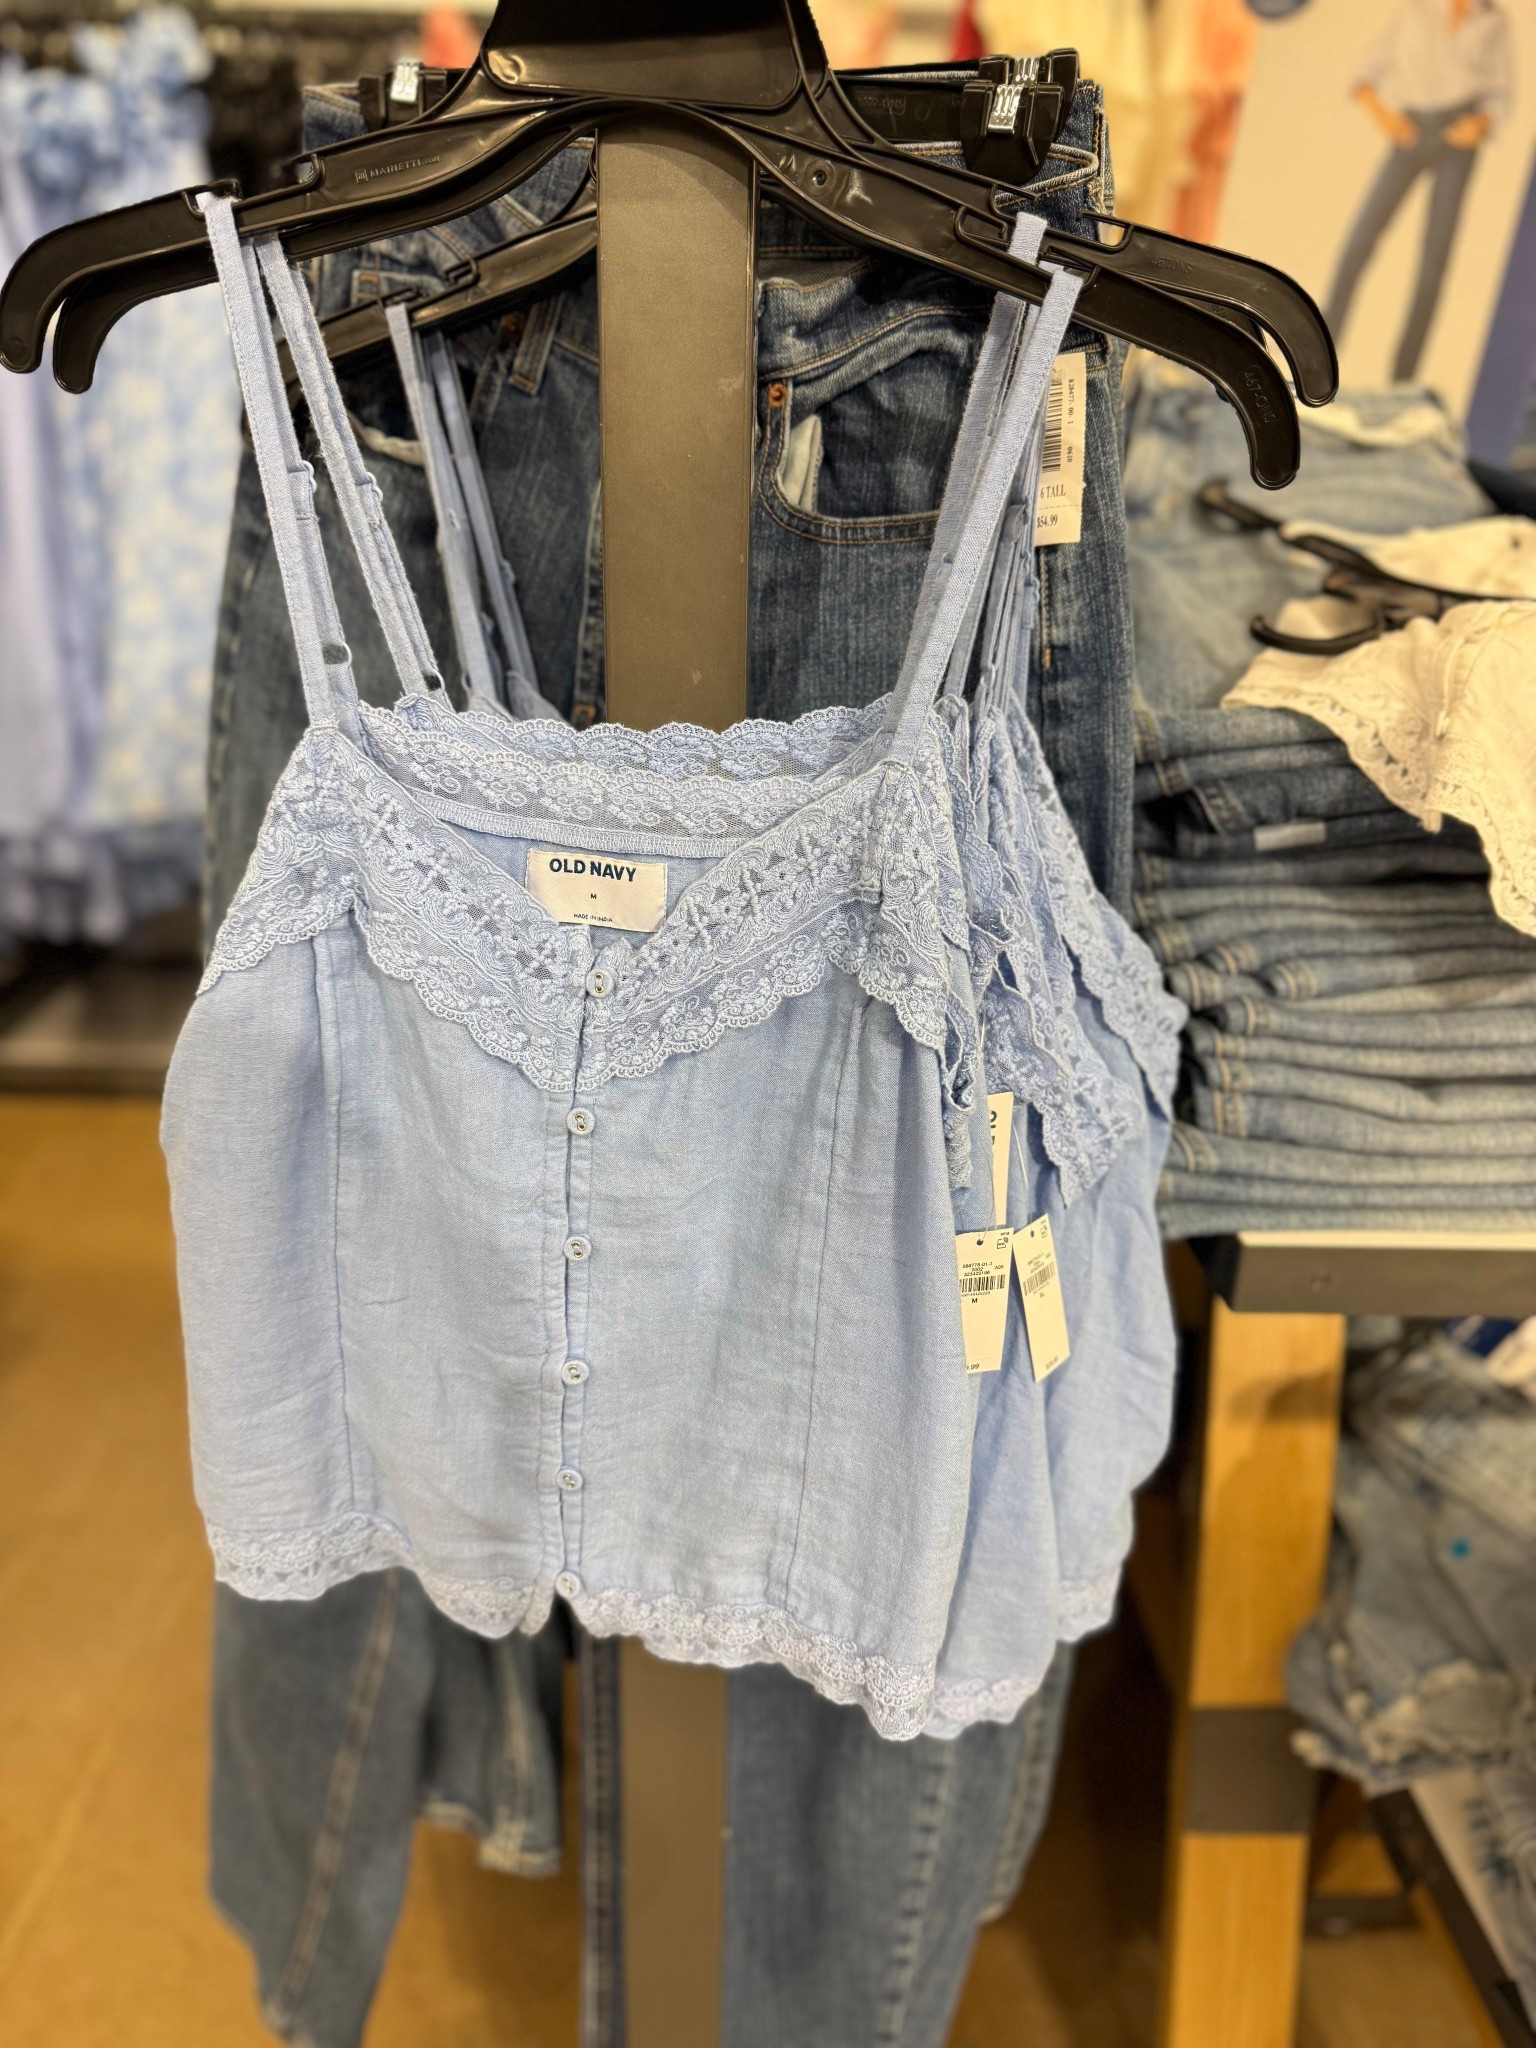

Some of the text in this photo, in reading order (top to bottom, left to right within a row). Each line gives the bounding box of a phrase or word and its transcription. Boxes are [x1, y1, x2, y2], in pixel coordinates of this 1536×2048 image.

[1040, 484, 1067, 499] 6 TALL
[549, 858, 637, 882] OLD NAVY
[590, 892, 597, 900] M
